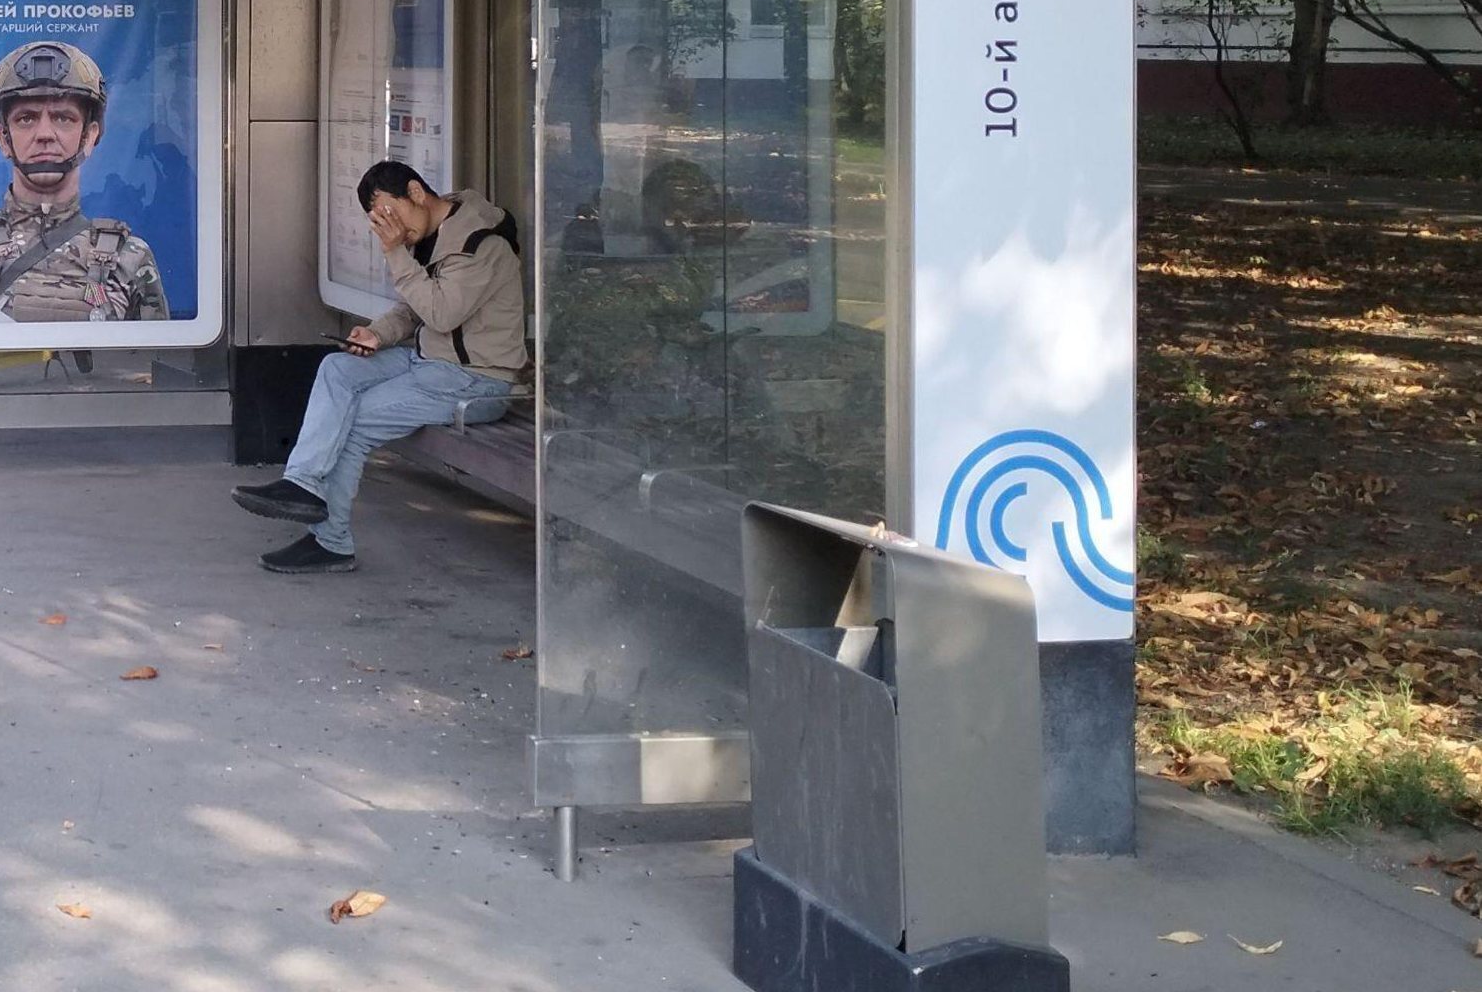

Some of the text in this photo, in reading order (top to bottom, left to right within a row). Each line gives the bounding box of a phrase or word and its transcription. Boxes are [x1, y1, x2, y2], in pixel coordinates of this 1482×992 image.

[23, 4, 135, 18] ПРОКОФЬЕВ
[46, 23, 99, 33] СЕРЖАНТ
[984, 40, 1018, 137] 10-й
